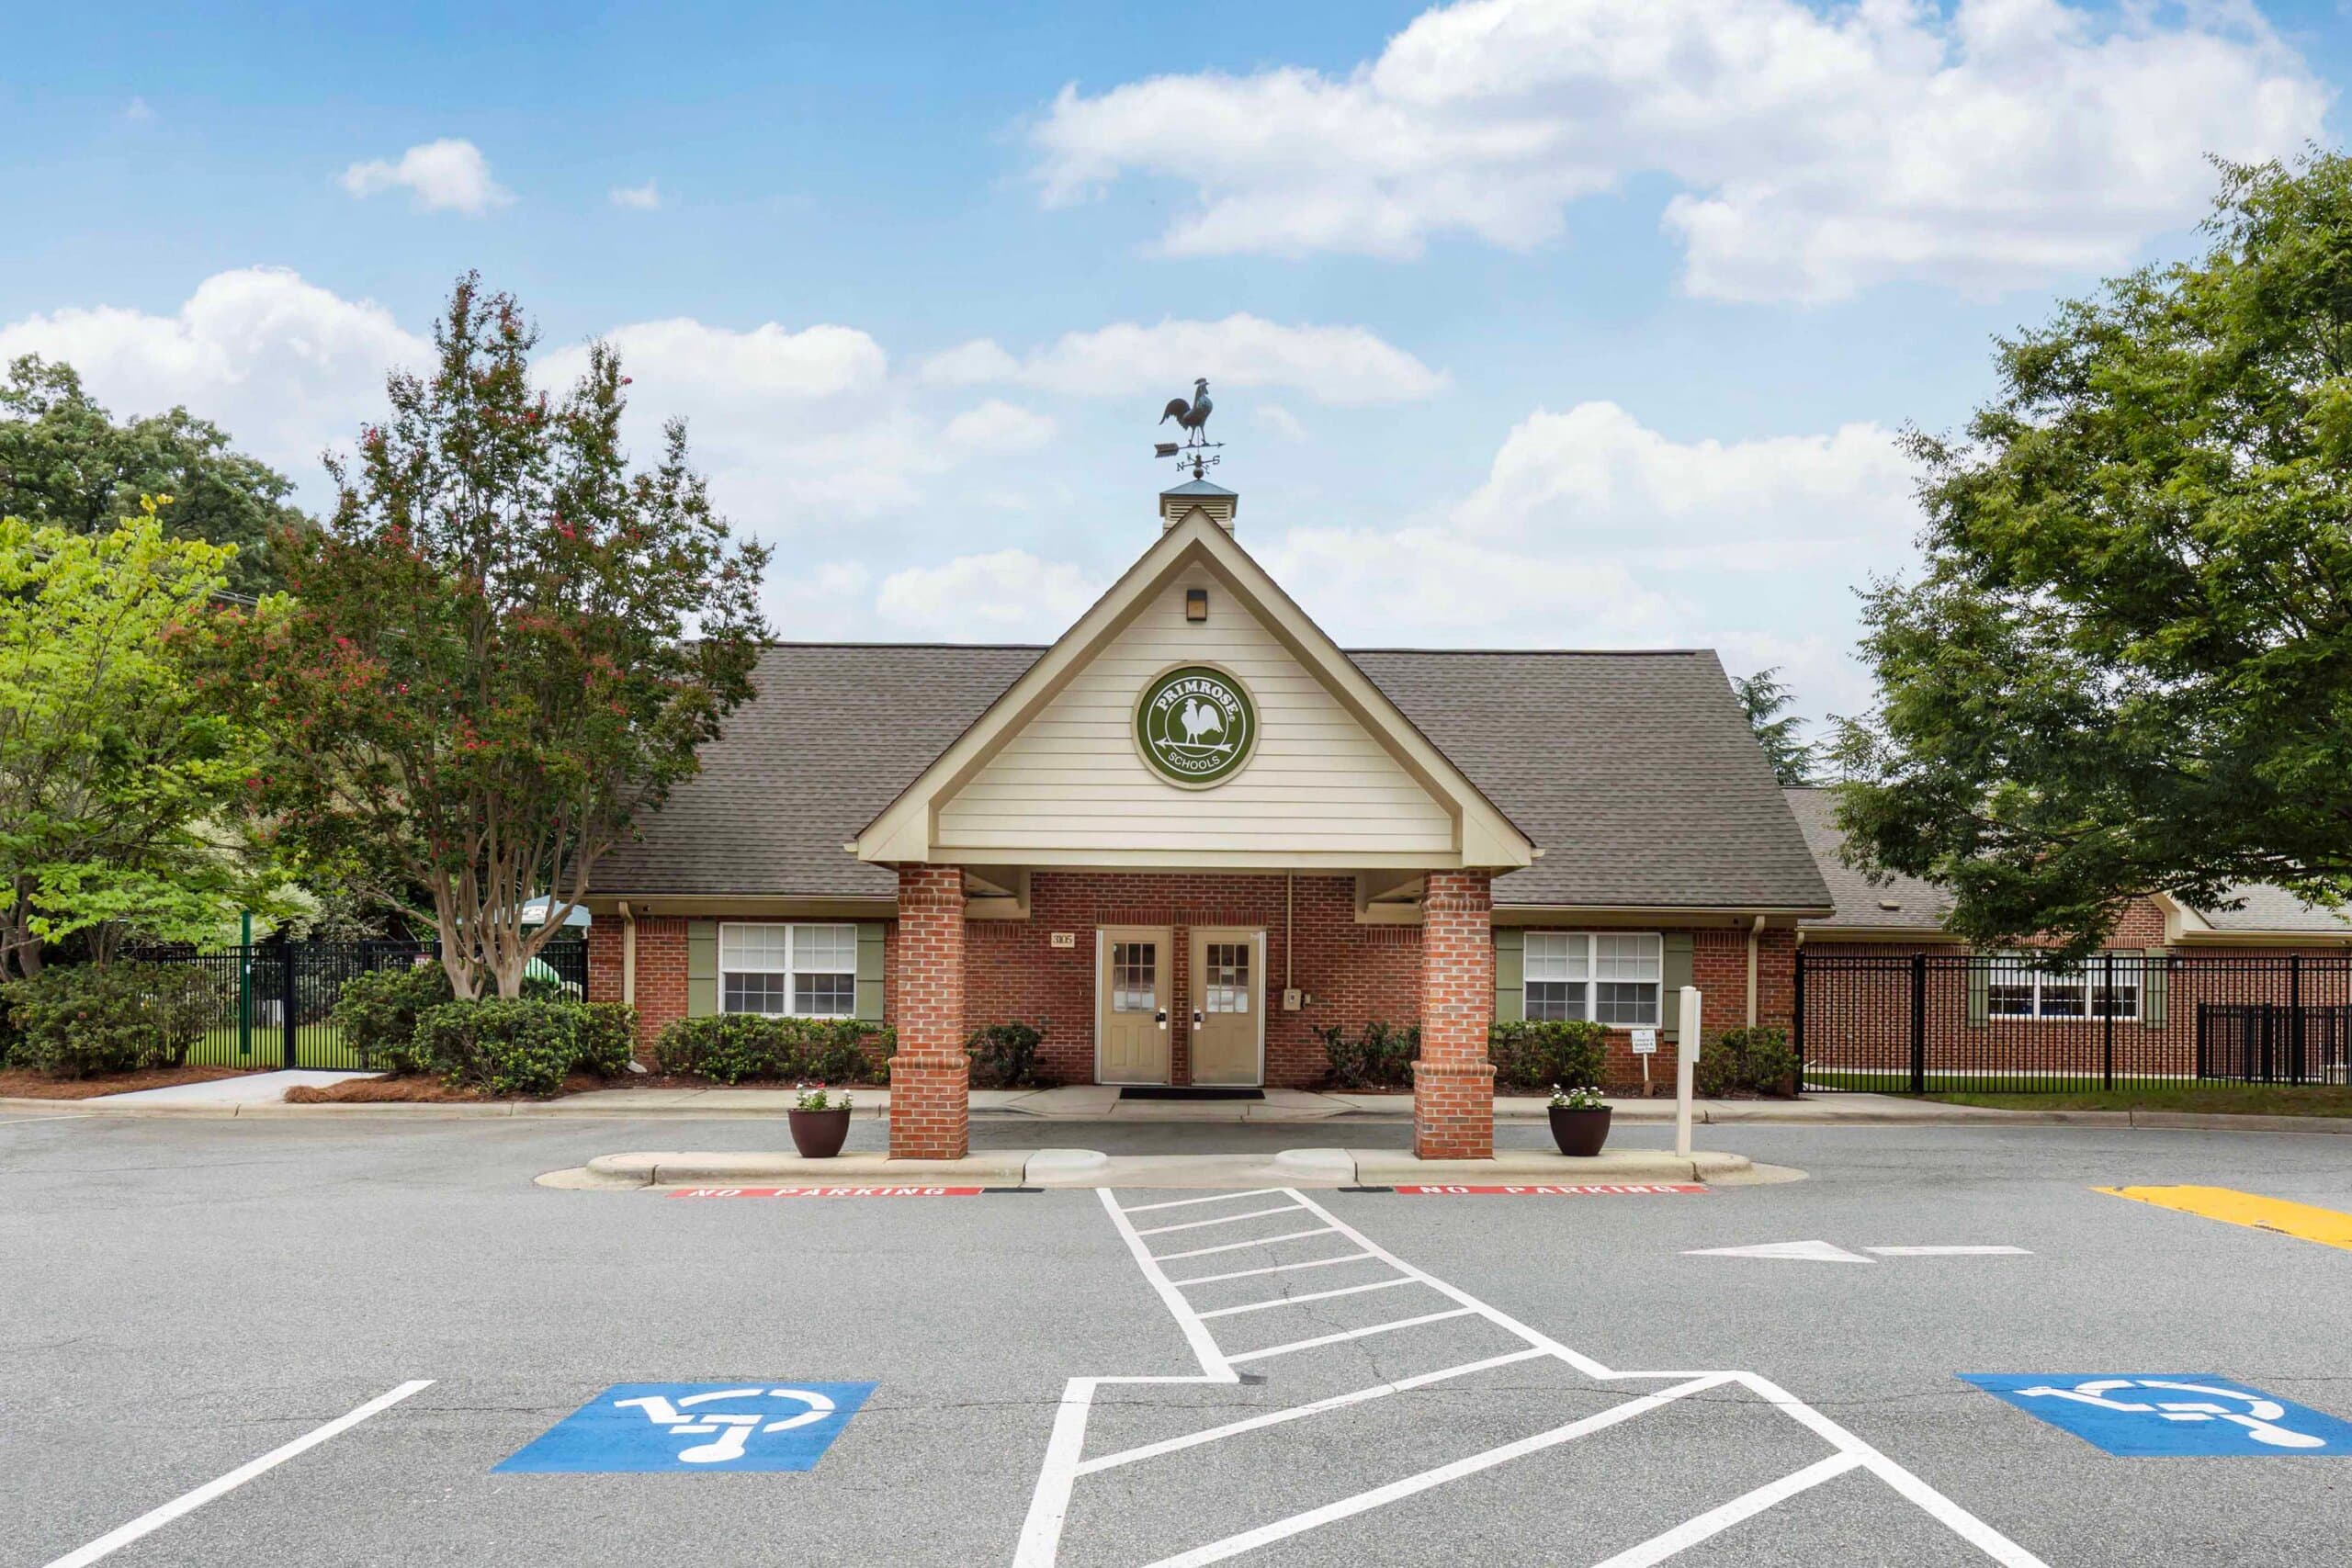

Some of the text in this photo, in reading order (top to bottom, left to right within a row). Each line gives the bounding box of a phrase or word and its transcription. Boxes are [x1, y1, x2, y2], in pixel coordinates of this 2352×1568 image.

[1157, 680, 1238, 715] PRIMROSE
[1168, 751, 1220, 770] SCHOOLS
[689, 1188, 947, 1197] NO PARKING
[1419, 1185, 1679, 1194] NO PARKING
